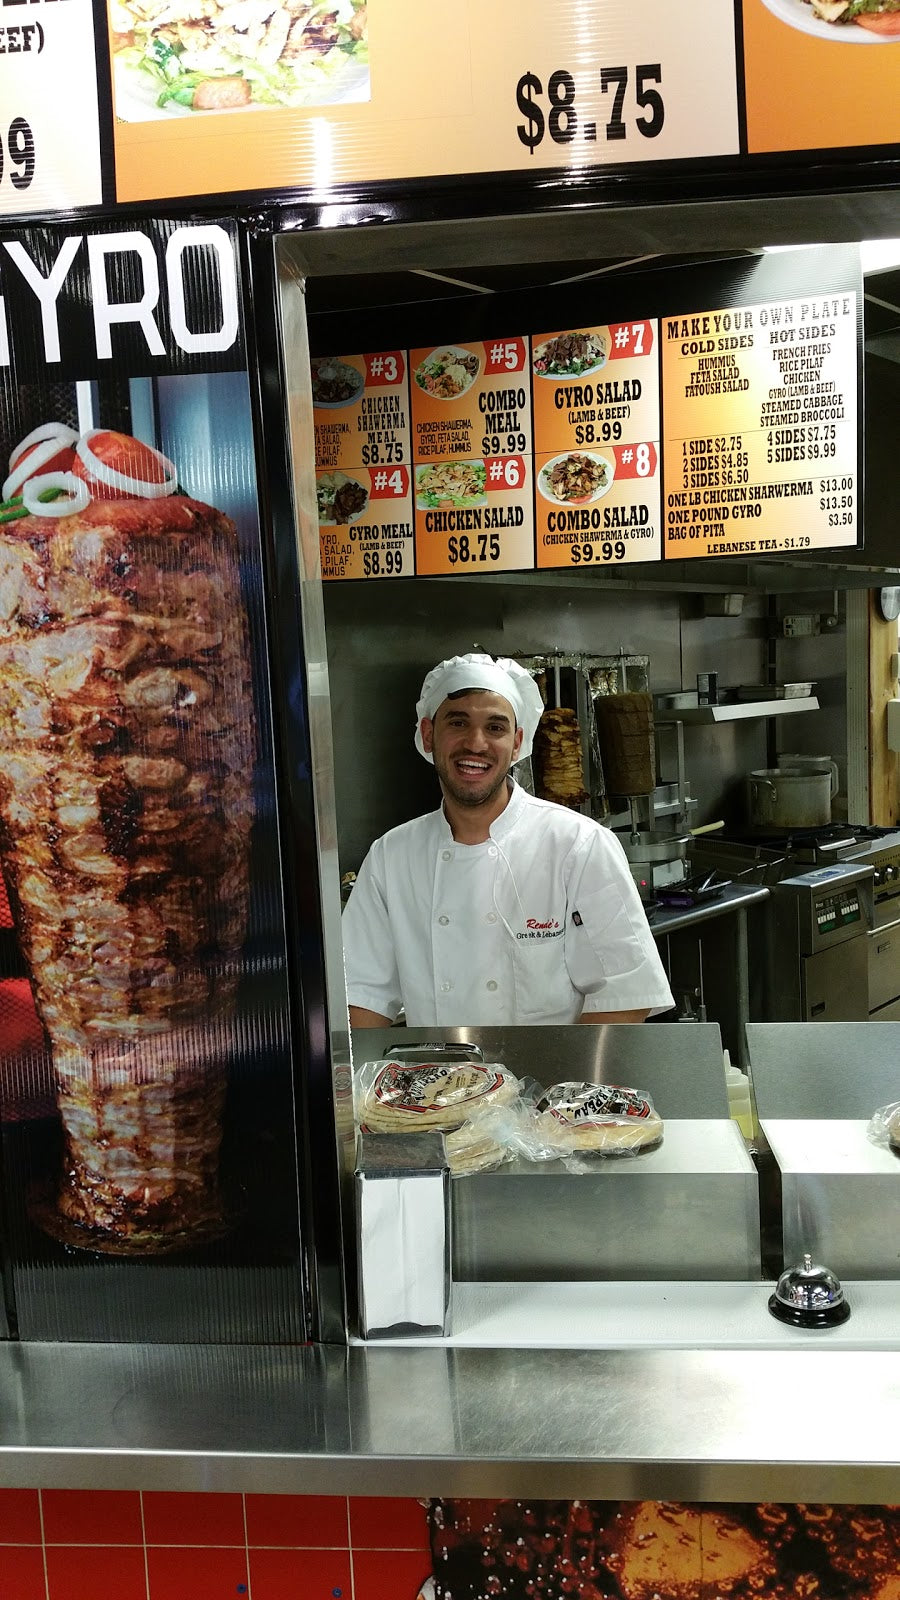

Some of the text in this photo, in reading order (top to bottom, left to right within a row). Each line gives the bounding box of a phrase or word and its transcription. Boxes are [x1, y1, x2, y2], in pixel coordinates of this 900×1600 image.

[516, 64, 664, 155] $8.75
[0, 224, 239, 367] YRO
[668, 298, 850, 339] MAKE YOUR OWN PLATE
[615, 324, 645, 354] #7
[770, 324, 836, 344] HOT SIDES
[490, 343, 518, 369] #5
[682, 335, 754, 356] COLD SIDES
[772, 343, 832, 361] FRENCH FRIES
[371, 356, 397, 381] #3
[698, 355, 736, 371] HUMMUS
[779, 357, 825, 373] RICE PILAF
[690, 367, 740, 384] FETA SALAD
[784, 370, 821, 385] CHICKEN
[554, 379, 642, 409] GYRO SALAD
[685, 378, 750, 398] FATOUSH SALAD
[768, 381, 836, 399] GYRO (LAMB & BEEF)
[362, 396, 400, 414] CHICKEN
[478, 388, 525, 413] COMBO
[761, 394, 844, 414] STEAMED CABBAGE
[358, 412, 405, 431] SHAWERMA
[485, 411, 520, 435] MEAL
[568, 404, 631, 425] (LAMB & BEEF)
[760, 407, 845, 428] STEAMED BROCCOLI
[368, 430, 397, 445] MEAL
[416, 422, 441, 433] CHICKEN
[438, 433, 450, 442] FETA
[575, 421, 622, 446] $8.99
[767, 425, 836, 446] 4 SIDES $7.75
[362, 443, 403, 467] $8.75
[418, 446, 431, 456] RICE
[449, 442, 471, 454] HUMMUS
[482, 434, 526, 457] $9.99
[682, 436, 742, 456] 1 SIDE $2.75
[767, 443, 836, 463] 5 SIDES $9.99
[622, 444, 650, 477] #8
[683, 452, 749, 473] 2 SIDES $4.85
[374, 470, 403, 494] #4
[490, 460, 520, 487] #6
[684, 469, 749, 488] 3 SIDES $6.50
[668, 478, 853, 508] ONE LB CHICKEN SHARWERMA $13.00
[425, 506, 524, 533] CHICKEN SALAD
[548, 505, 649, 532] COMBO SALAD
[668, 496, 853, 525] ONE POUND GYRO $13.50
[350, 524, 413, 541] GYRO MEAL
[543, 526, 654, 546] (CHICKEN SHAWERMA & GYRO)
[668, 512, 853, 541] BAG OF PITA $3.50
[320, 534, 340, 545] YRO,
[324, 544, 355, 555] SALAD,
[360, 541, 405, 551] (LAMB & BEEF)
[448, 534, 500, 566] $8.75
[708, 540, 756, 554] LEBANESE
[571, 542, 626, 564] $9.99
[364, 551, 402, 578] $8.99
